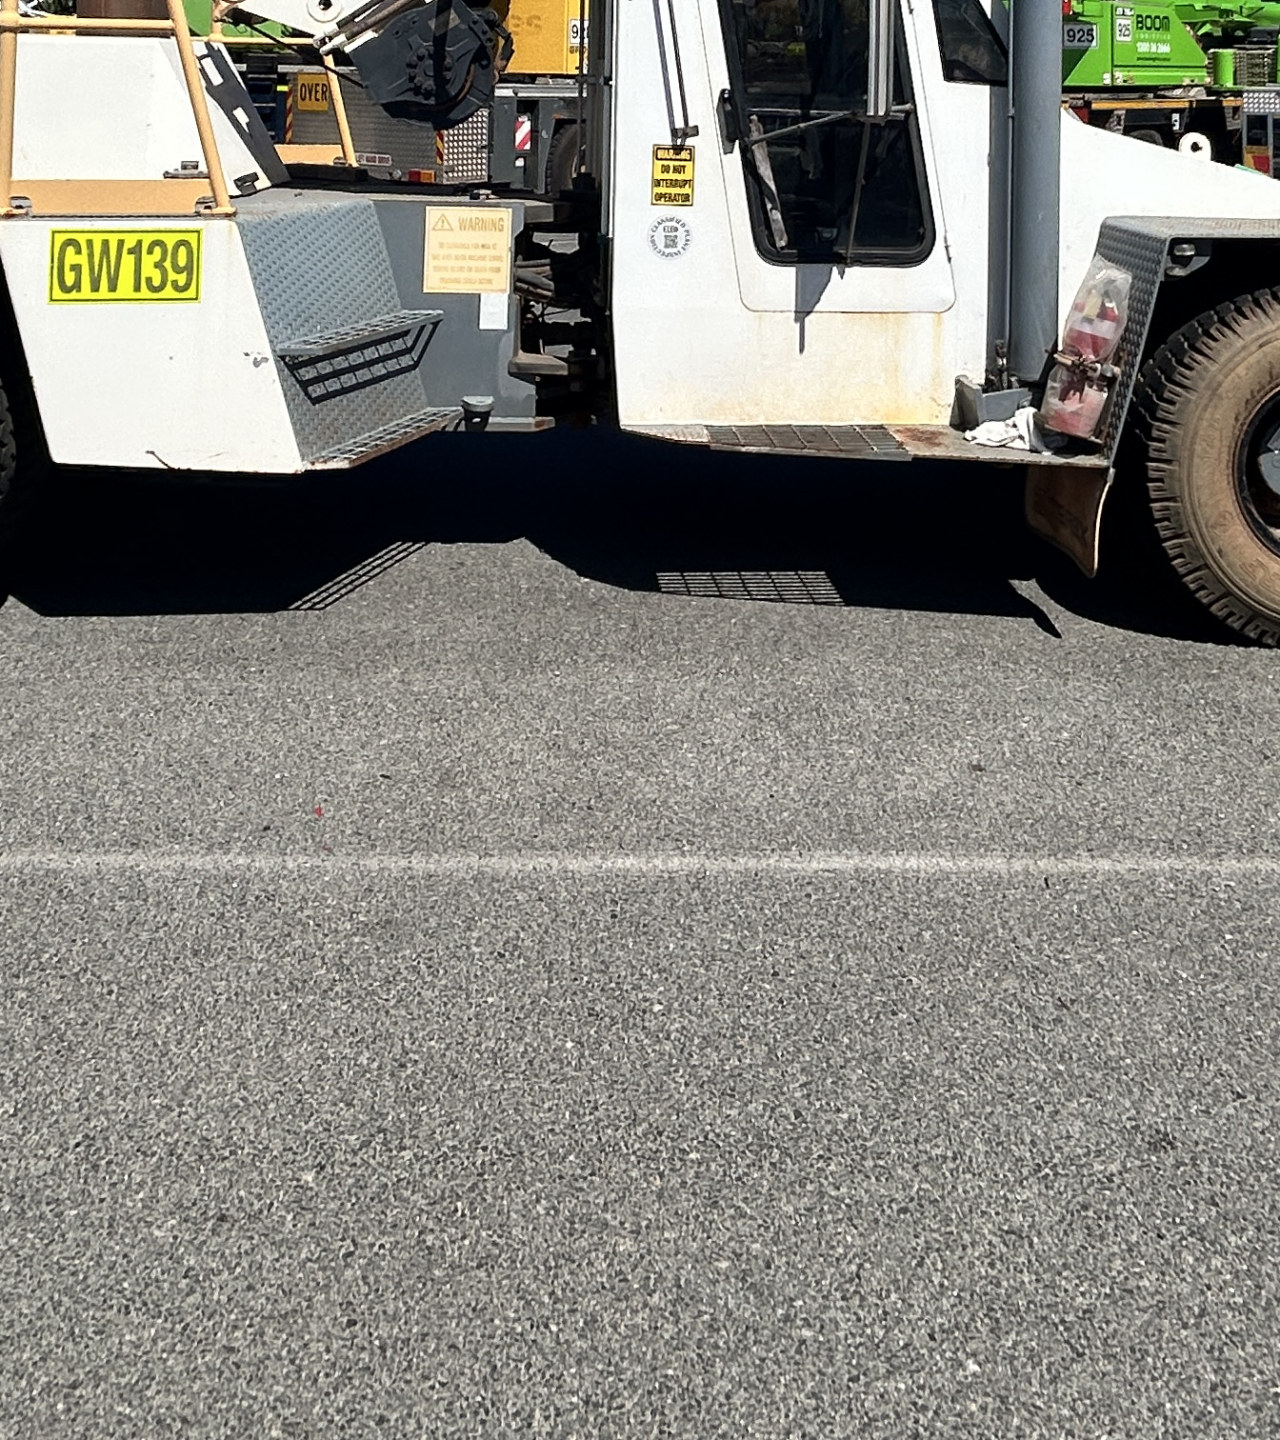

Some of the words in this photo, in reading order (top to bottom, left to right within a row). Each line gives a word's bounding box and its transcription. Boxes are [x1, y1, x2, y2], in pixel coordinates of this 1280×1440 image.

[1135, 14, 1170, 32] BOOM
[1066, 27, 1095, 44] 925
[300, 82, 328, 102] OVER
[661, 164, 671, 174] DO
[672, 164, 687, 175] NOT
[653, 178, 693, 189] INTERRUPT
[654, 192, 691, 203] OPERATOR
[458, 217, 505, 233] WARNING
[56, 237, 195, 295] GW139
